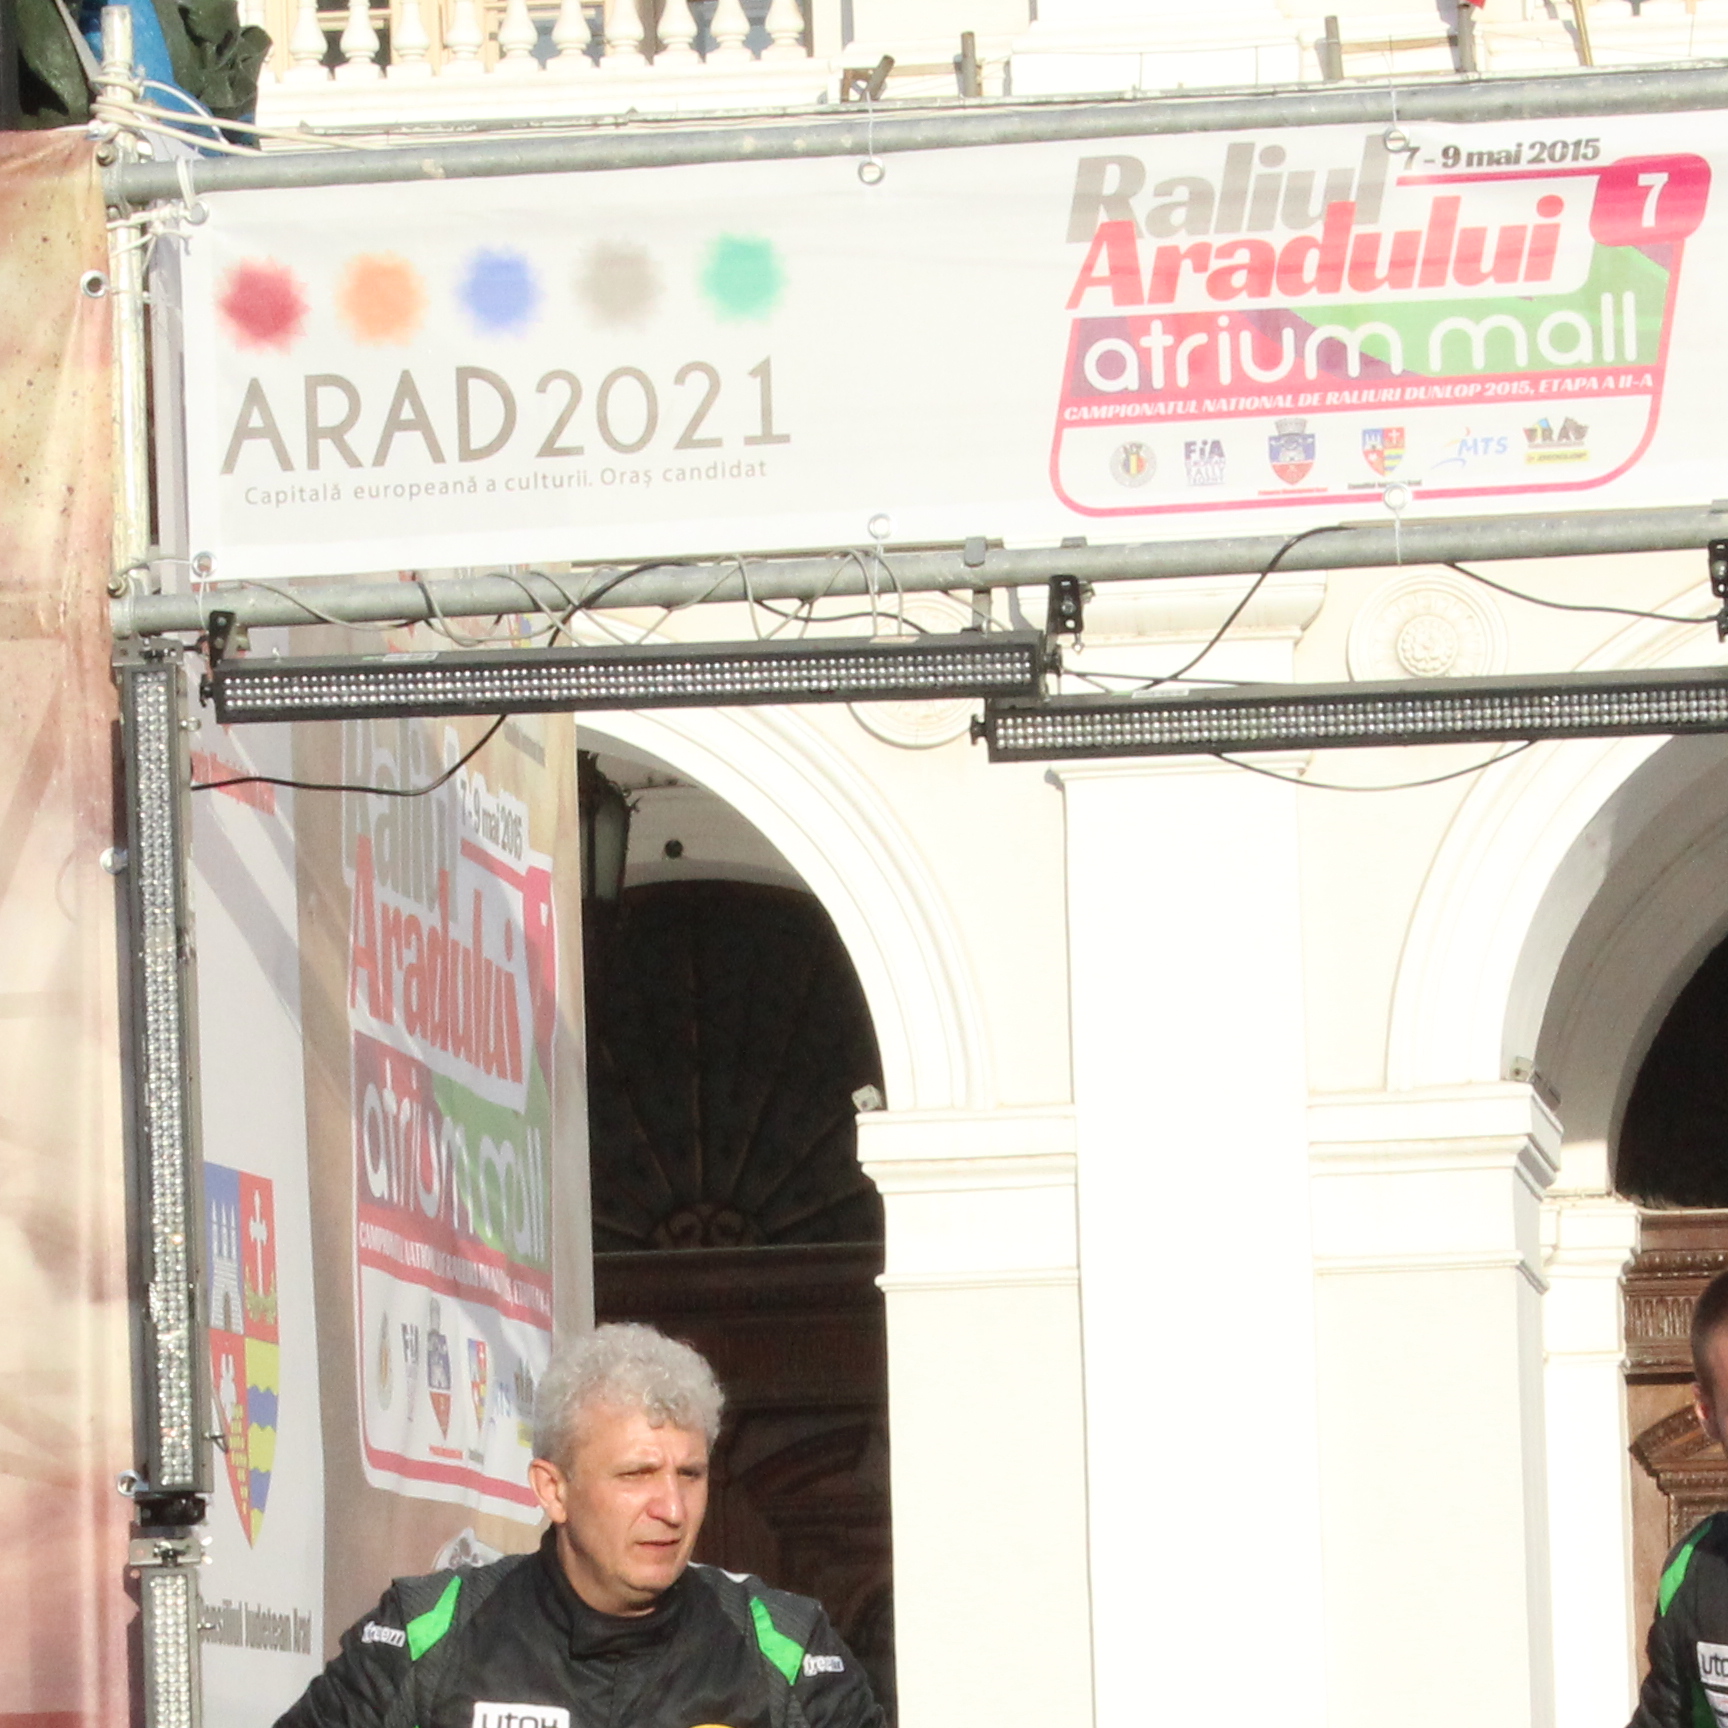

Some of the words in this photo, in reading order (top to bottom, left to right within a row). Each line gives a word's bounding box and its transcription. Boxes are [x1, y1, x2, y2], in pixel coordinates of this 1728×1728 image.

[1065, 134, 1392, 244] Raliul
[1440, 145, 1462, 169] 9
[1465, 143, 1523, 168] mai
[1527, 138, 1602, 163] 2015
[1636, 172, 1670, 228] 7
[1065, 193, 1565, 311] Aradului
[1083, 314, 1404, 393] atrium
[1428, 290, 1638, 374] mall
[221, 356, 791, 475] ARAD2021
[1063, 399, 1199, 422] CAMPIONATUL
[1201, 394, 1296, 414] NATIONAL
[1296, 393, 1324, 408] DE
[1325, 385, 1410, 406] RALIURI
[1410, 383, 1482, 402] DUNLOP
[1538, 375, 1601, 393] ETAPA
[1600, 374, 1616, 389] A
[243, 482, 343, 508] Capitală
[352, 475, 480, 501] europeană
[485, 478, 498, 494] a
[504, 468, 593, 493] culturii.
[661, 458, 768, 484] candidat
